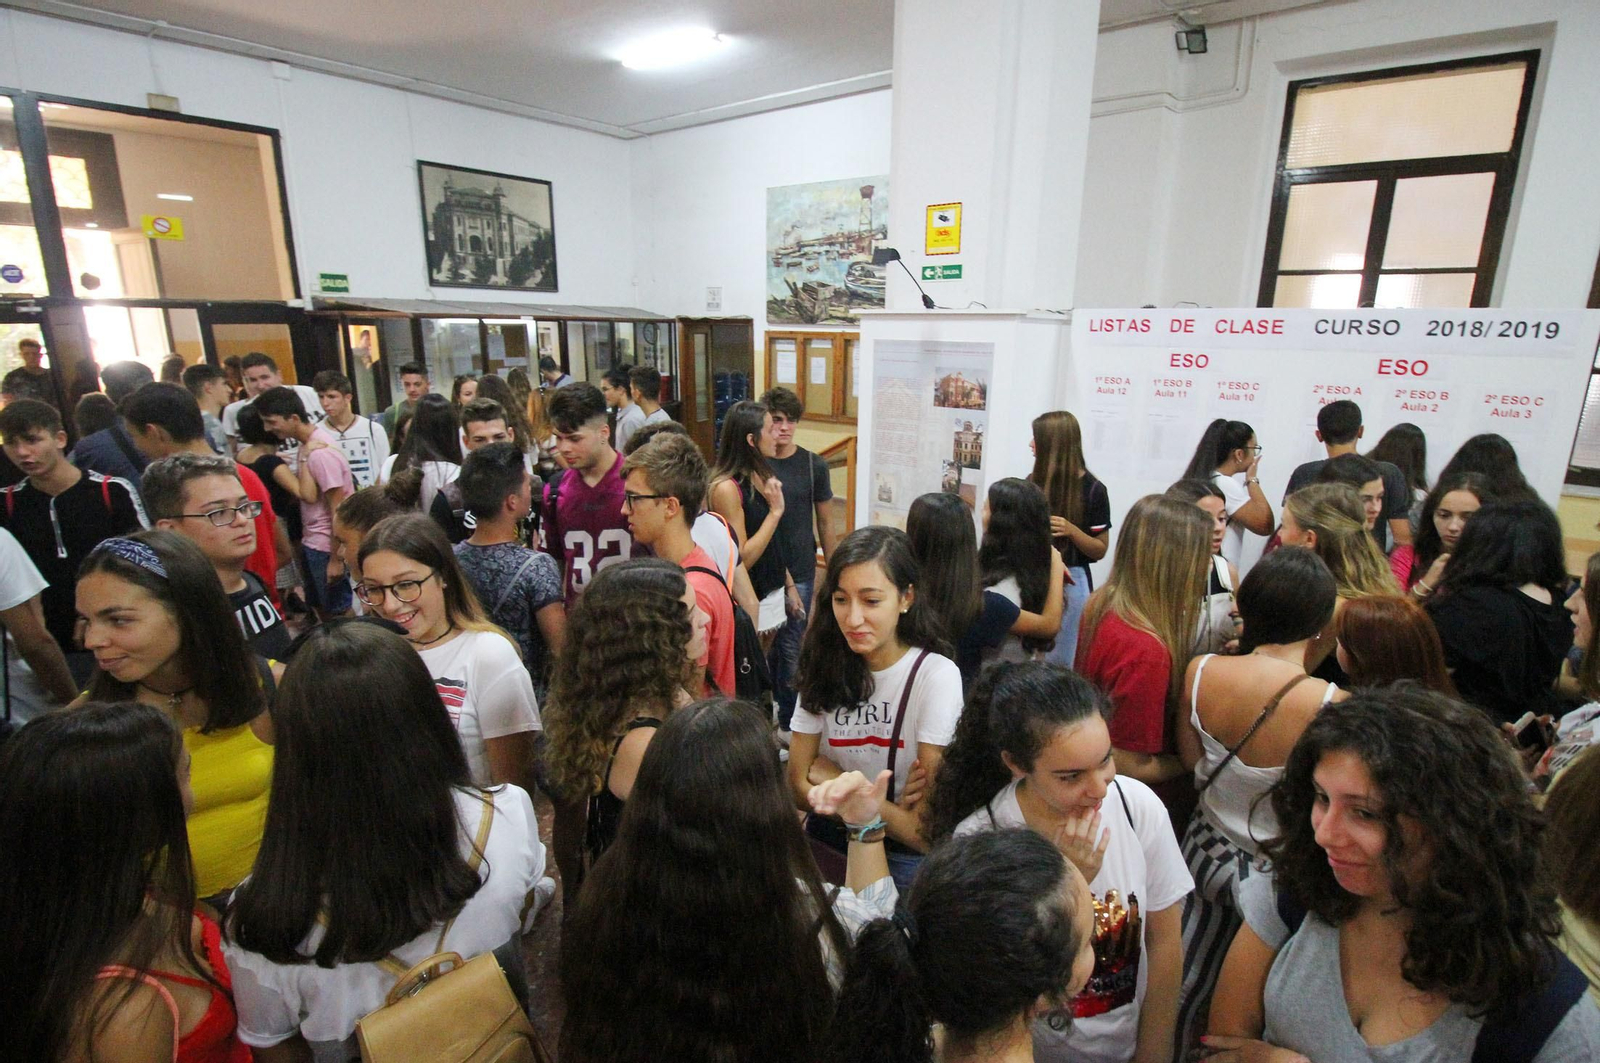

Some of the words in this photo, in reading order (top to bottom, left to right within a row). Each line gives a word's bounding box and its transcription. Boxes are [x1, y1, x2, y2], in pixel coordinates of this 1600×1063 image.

[1090, 319, 1150, 332] LISTAS
[1170, 319, 1195, 333] DE
[1215, 319, 1284, 334] CLASE
[1315, 319, 1400, 335] CURSO
[1170, 354, 1208, 368] ESO
[1378, 359, 1428, 376] ESO
[1104, 376, 1122, 384] ESO
[1124, 378, 1130, 386] A
[1164, 378, 1184, 388] ESO
[1186, 380, 1192, 388] B
[1228, 382, 1250, 390] ESO
[1252, 382, 1260, 390] C
[1096, 386, 1114, 394] Aula
[1118, 388, 1126, 396] 12
[1154, 390, 1174, 398] Aula
[1326, 386, 1350, 394] ESO
[1354, 386, 1362, 396] A
[1410, 390, 1436, 400] ESO
[1440, 392, 1450, 400] B
[1218, 392, 1240, 400] Aula
[1244, 394, 1254, 402] 10
[1500, 396, 1530, 406] ESO
[1534, 396, 1544, 406] C
[1400, 402, 1428, 412] Aula
[1430, 404, 1438, 412] 2
[1490, 408, 1520, 418] Aula
[1524, 410, 1532, 418] 3
[564, 529, 631, 594] 32
[835, 702, 891, 726] GIRL
